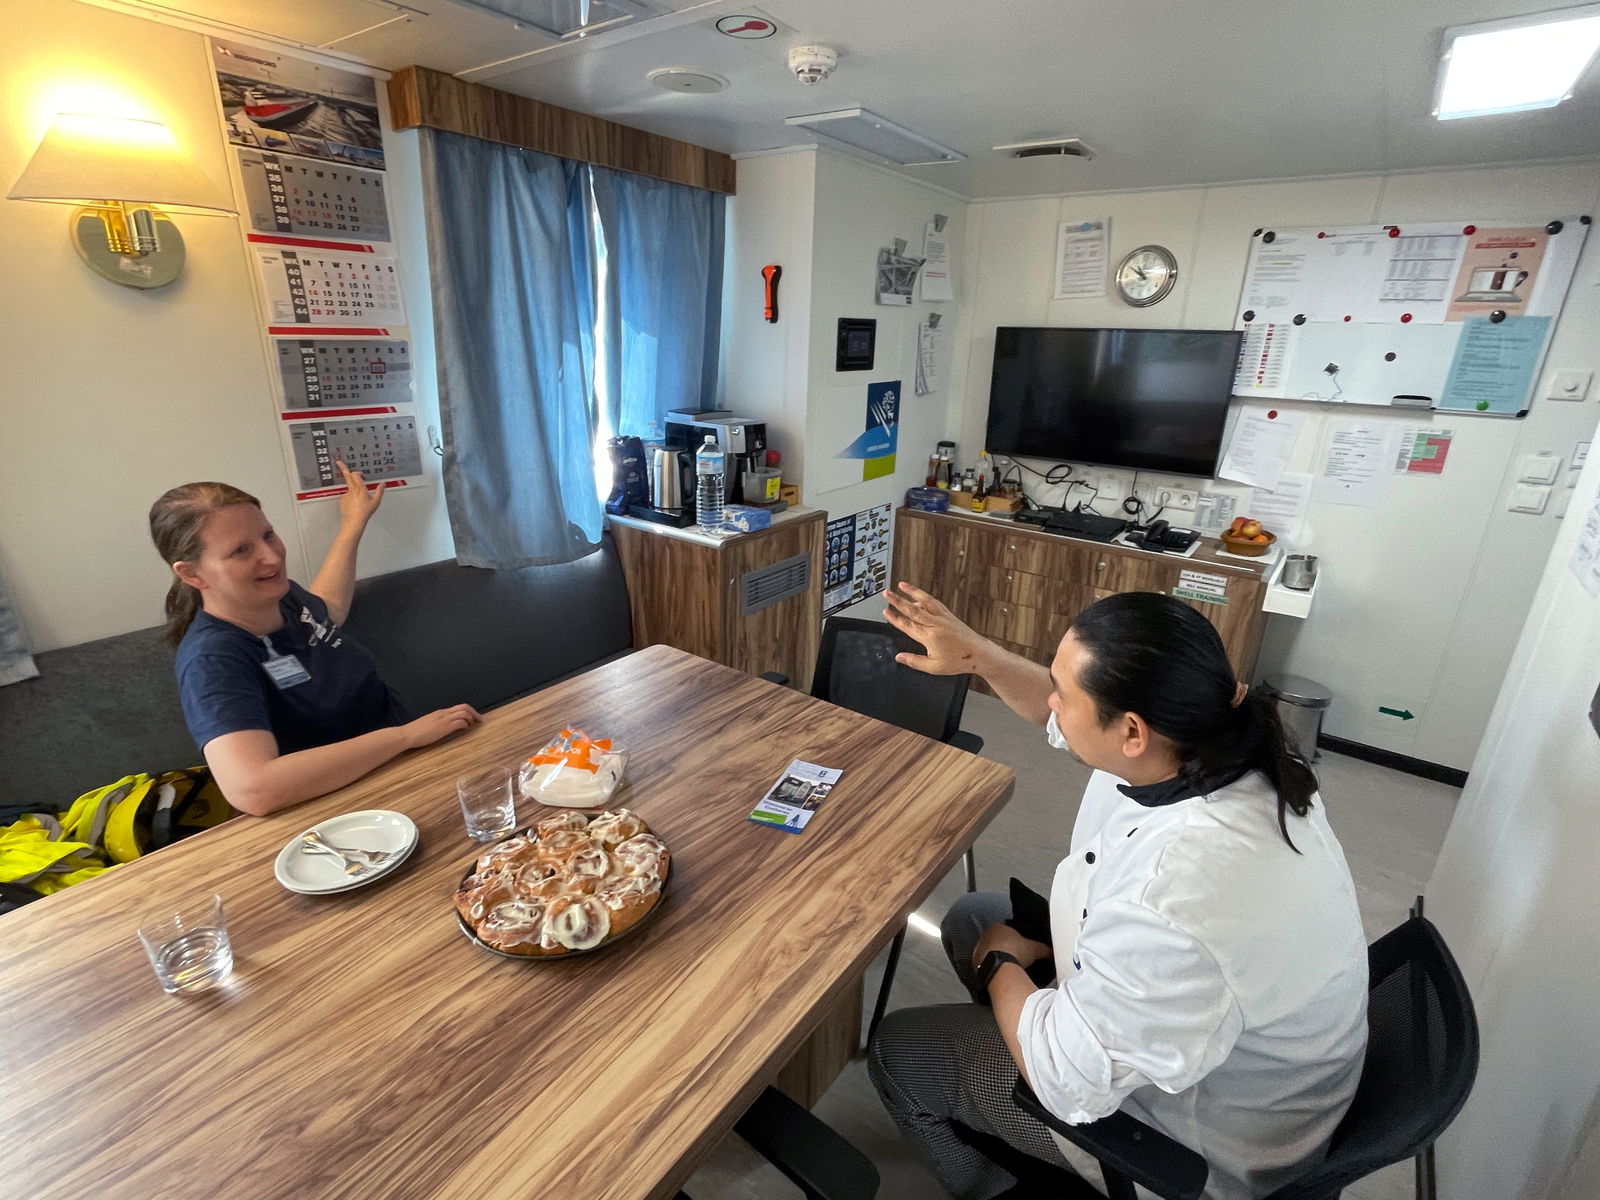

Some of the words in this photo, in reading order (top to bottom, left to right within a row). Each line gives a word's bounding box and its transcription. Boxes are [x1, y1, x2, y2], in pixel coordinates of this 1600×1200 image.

[264, 162, 280, 170] WK
[268, 174, 281, 182] 35
[273, 195, 285, 203] 37
[292, 288, 304, 296] 42
[1176, 589, 1194, 597] SHELL
[1196, 593, 1227, 604] TRAINING
